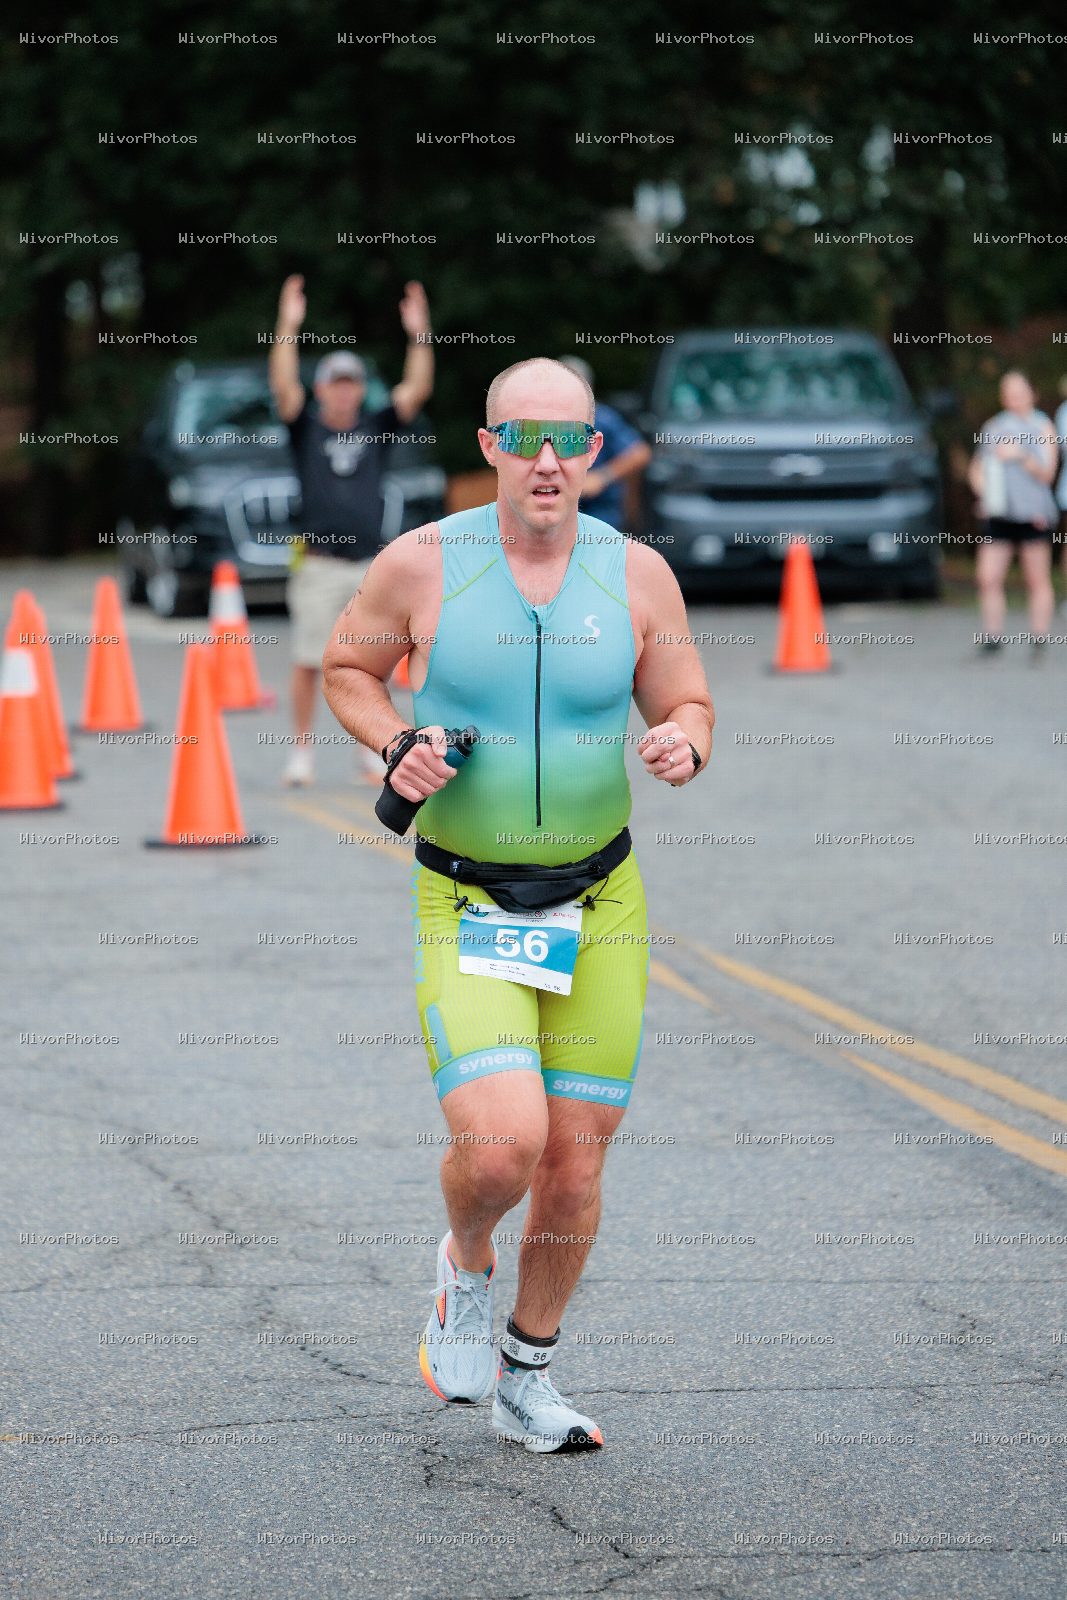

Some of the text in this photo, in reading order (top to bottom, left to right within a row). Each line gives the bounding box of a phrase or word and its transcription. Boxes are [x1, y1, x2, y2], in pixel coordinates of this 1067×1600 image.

[494, 928, 549, 963] 56
[458, 1051, 534, 1076] synergy
[552, 1078, 628, 1100] synergy
[532, 1352, 548, 1362] 56
